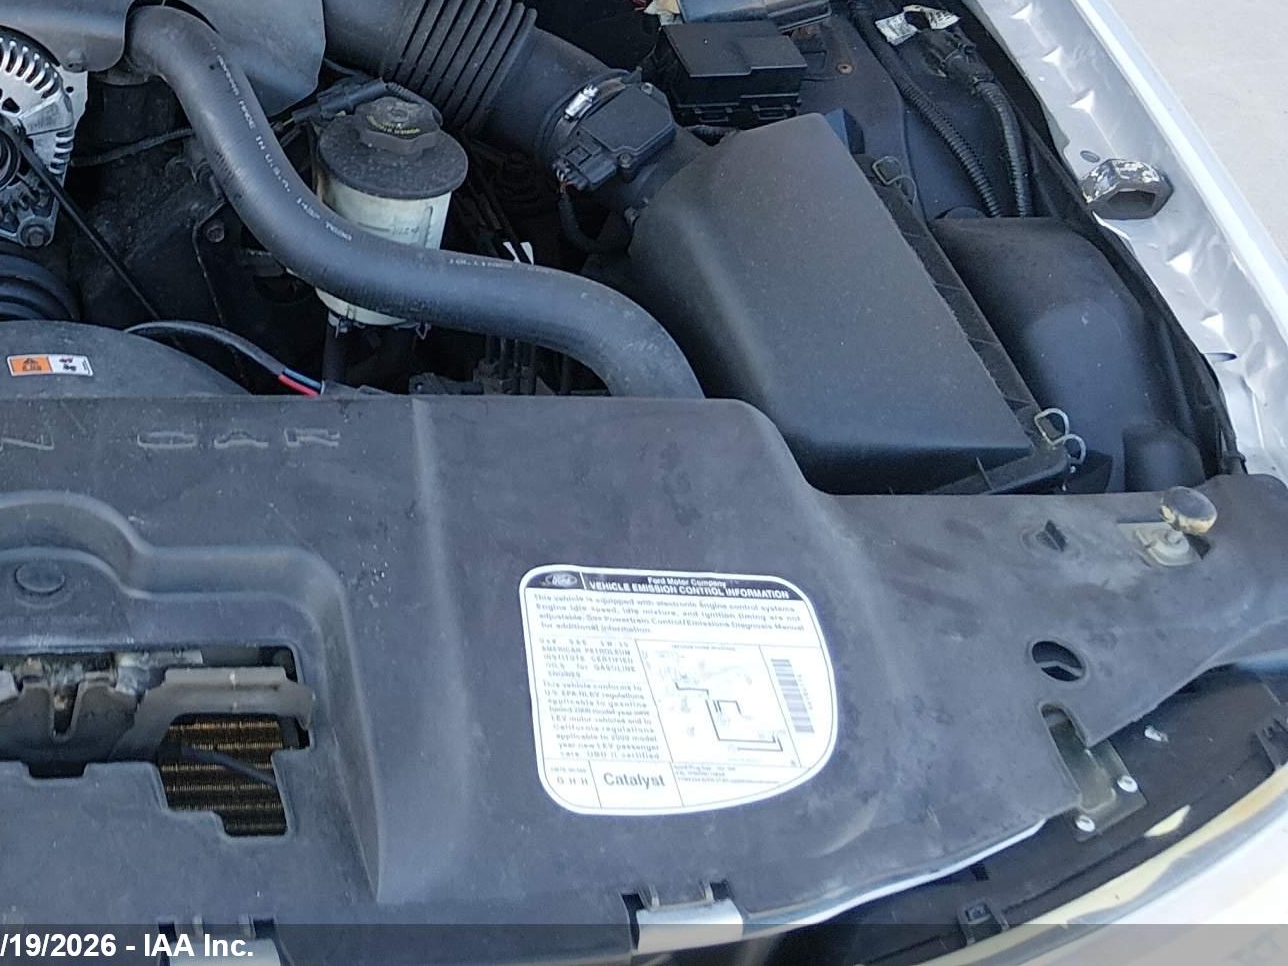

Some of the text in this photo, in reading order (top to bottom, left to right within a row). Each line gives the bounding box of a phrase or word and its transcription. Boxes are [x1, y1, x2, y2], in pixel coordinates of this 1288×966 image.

[137, 428, 341, 451] CAR
[589, 581, 790, 600] VEHICLE EMISSION CONTROL INFORMATION
[648, 577, 727, 589] Ford Motor Company
[554, 594, 584, 602] vehicle
[603, 772, 666, 790] Catalyst
